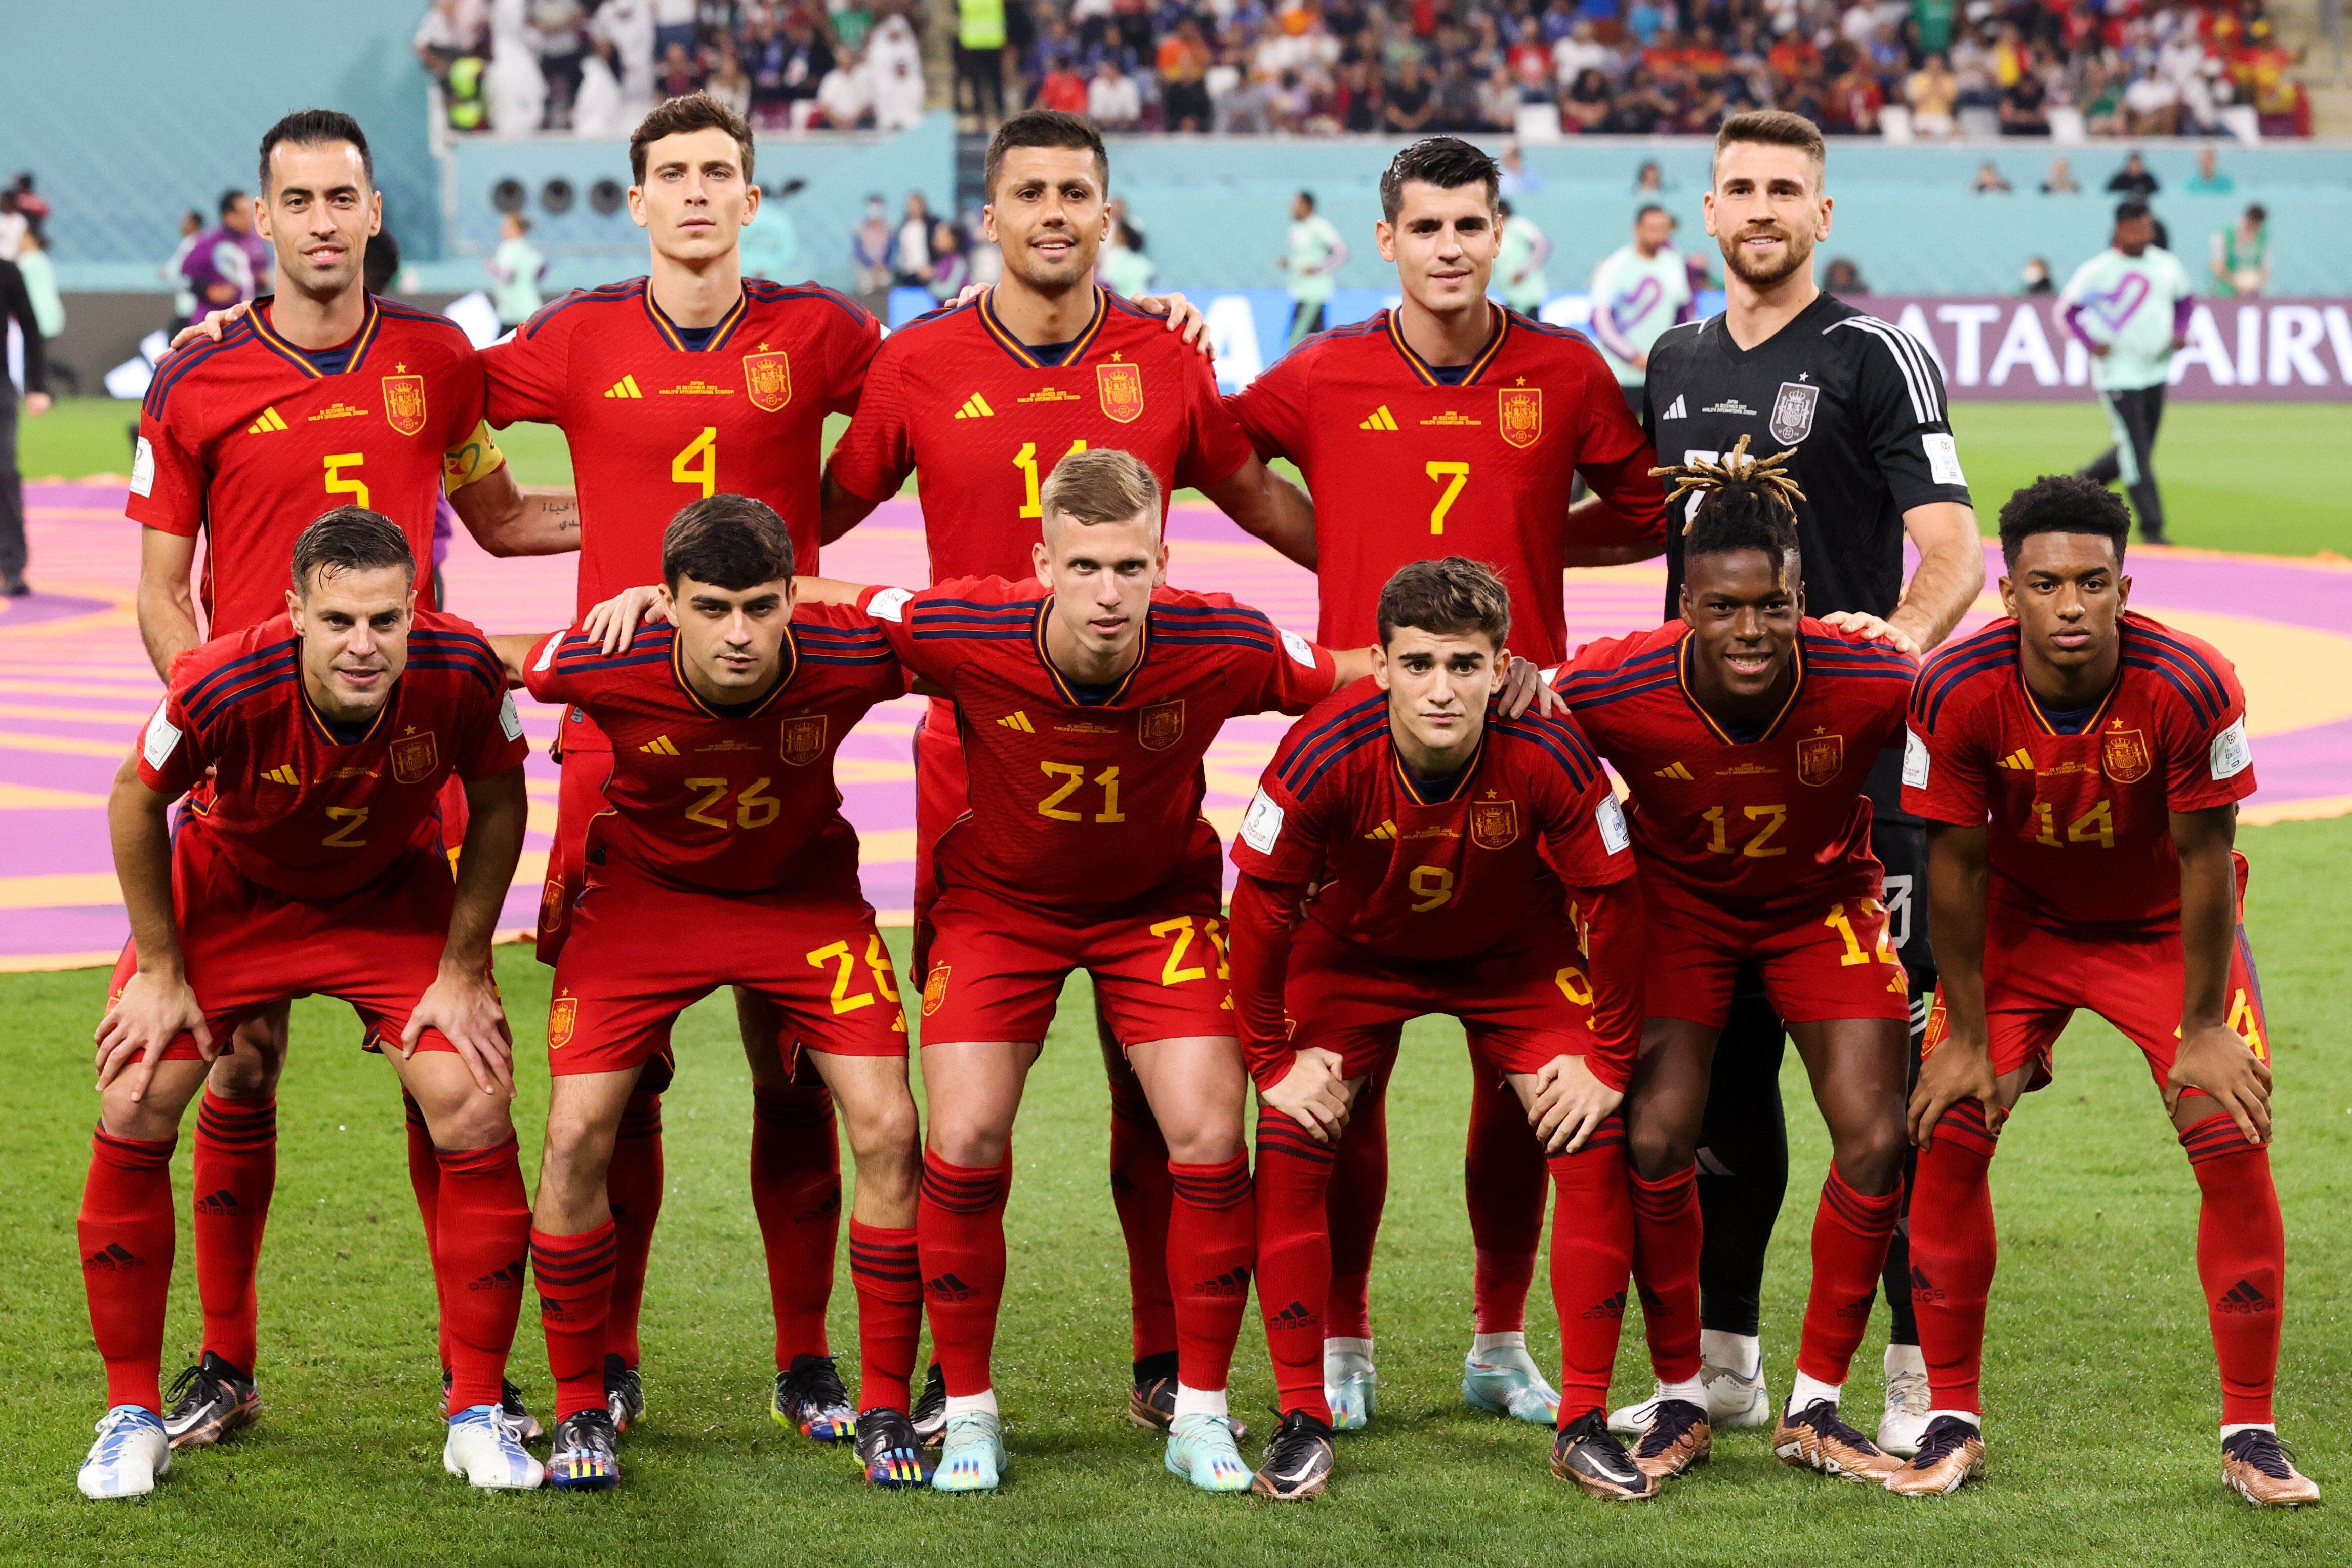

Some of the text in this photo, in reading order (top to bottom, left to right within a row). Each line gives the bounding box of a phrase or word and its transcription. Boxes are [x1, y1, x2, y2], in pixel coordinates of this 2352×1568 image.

[1897, 303, 2089, 387] ATA
[323, 452, 369, 508] 5
[672, 427, 716, 498] 4
[1012, 440, 1088, 518] 1
[1425, 461, 1469, 535] 7
[2225, 748, 2241, 759] UNITES
[684, 777, 780, 829] 26
[1038, 761, 1125, 823] 21
[322, 806, 368, 847] 2
[1702, 804, 1787, 857] 12
[2032, 799, 2115, 849] 14
[1409, 866, 1453, 912] 9
[1149, 915, 1230, 986] 21
[1824, 897, 1901, 967] 12
[806, 934, 901, 1015] 26
[1266, 1315, 1318, 1330] adidas
[1913, 1289, 1946, 1301] das
